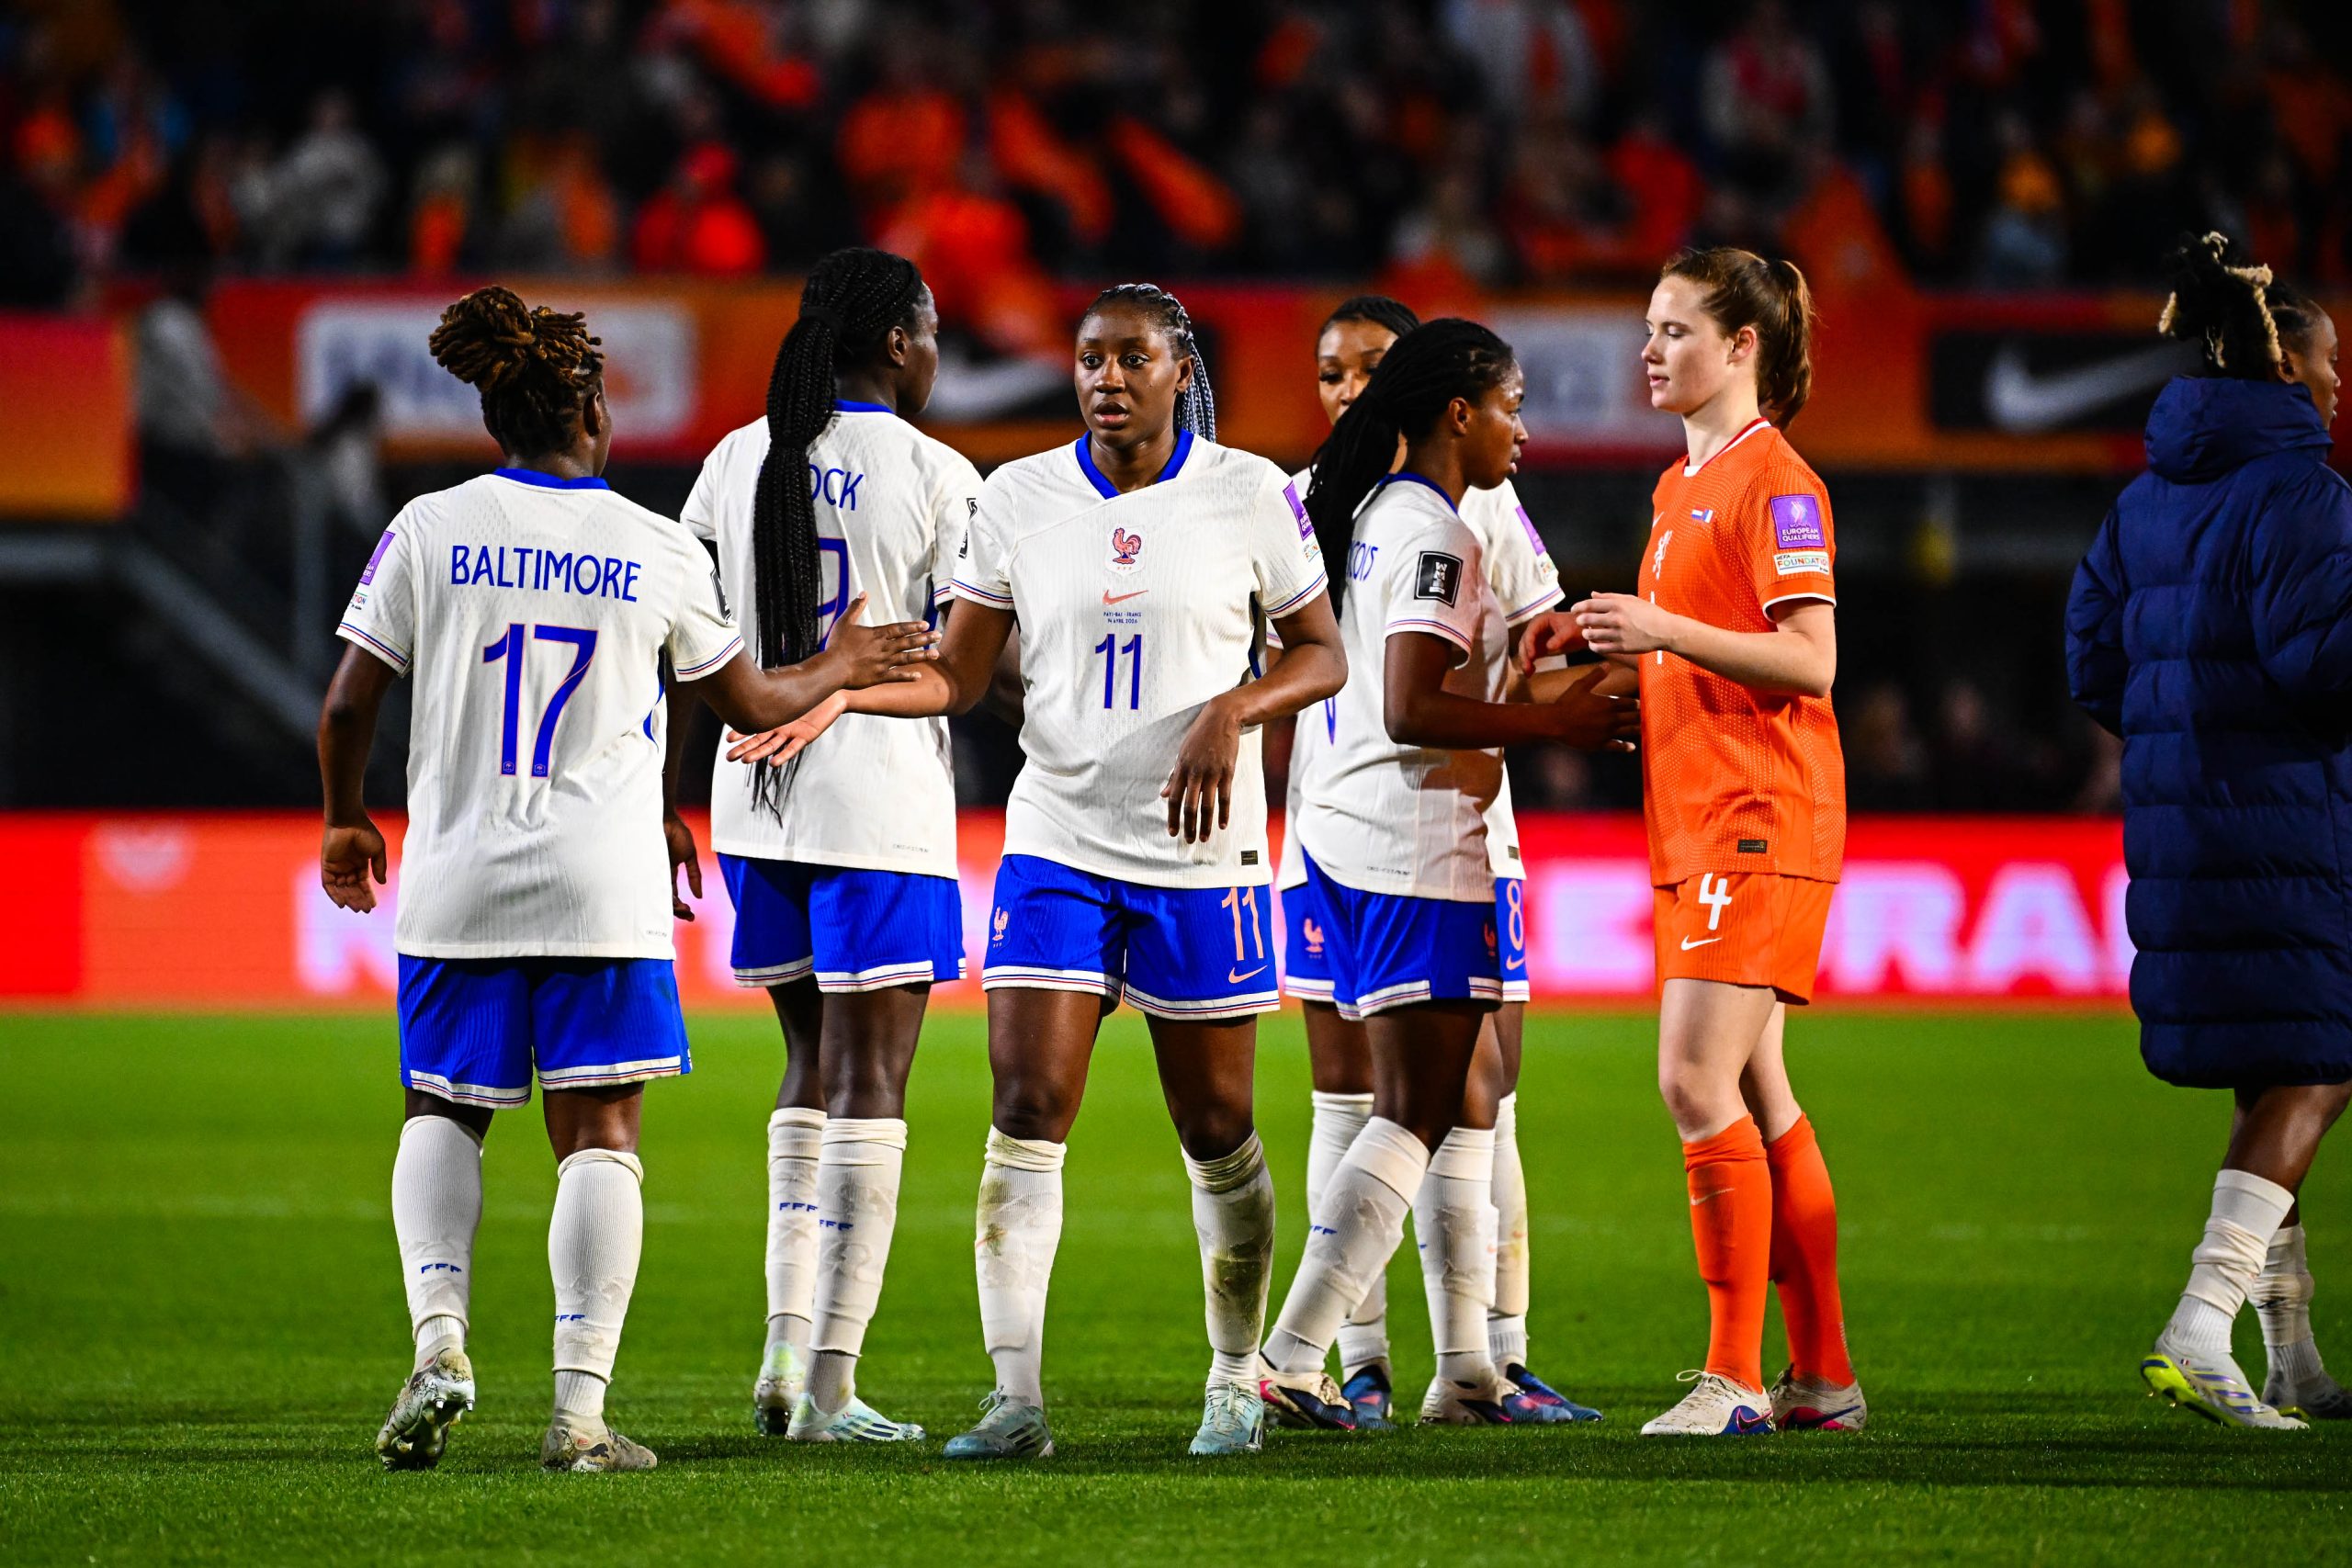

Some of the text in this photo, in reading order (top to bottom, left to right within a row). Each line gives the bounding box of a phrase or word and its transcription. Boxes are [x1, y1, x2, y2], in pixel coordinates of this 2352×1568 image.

[1781, 527, 1818, 536] EUROPEAN
[1782, 534, 1820, 542] QUALIFIERS
[451, 545, 640, 603] BALTIMORE
[482, 622, 599, 778] 17
[1095, 633, 1142, 710] 11
[1221, 886, 1264, 961] 11
[1507, 879, 1524, 952] 8
[1697, 873, 1733, 931] 4
[778, 1202, 819, 1213] FFF
[421, 1262, 462, 1274] FFF
